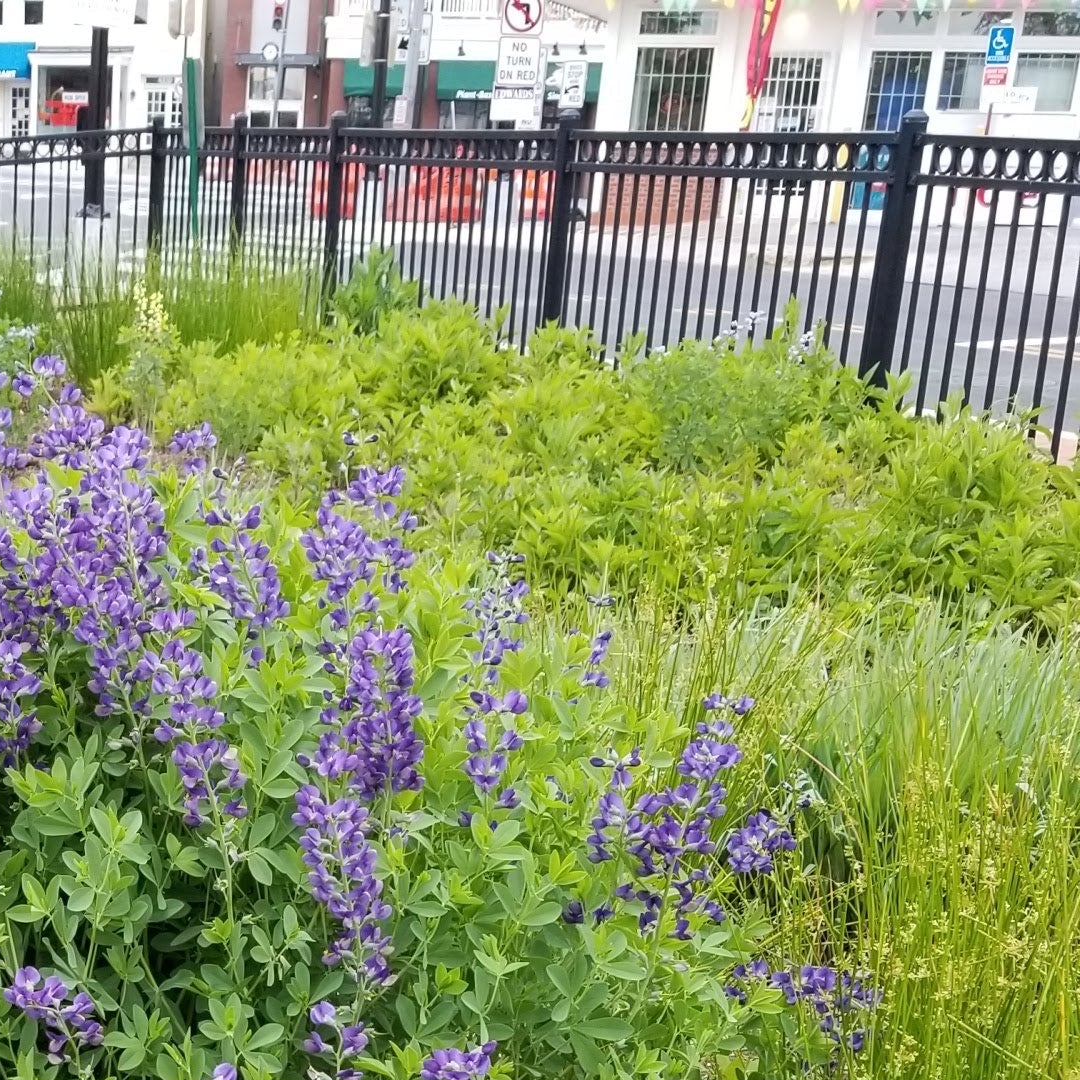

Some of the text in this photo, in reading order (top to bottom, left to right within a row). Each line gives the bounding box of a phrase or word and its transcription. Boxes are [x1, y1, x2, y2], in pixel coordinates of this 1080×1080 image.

[512, 43, 527, 51] NO
[506, 56, 531, 66] TURN
[500, 70, 535, 81] ON RED
[568, 71, 583, 79] STOP
[495, 89, 534, 99] EDWARDS
